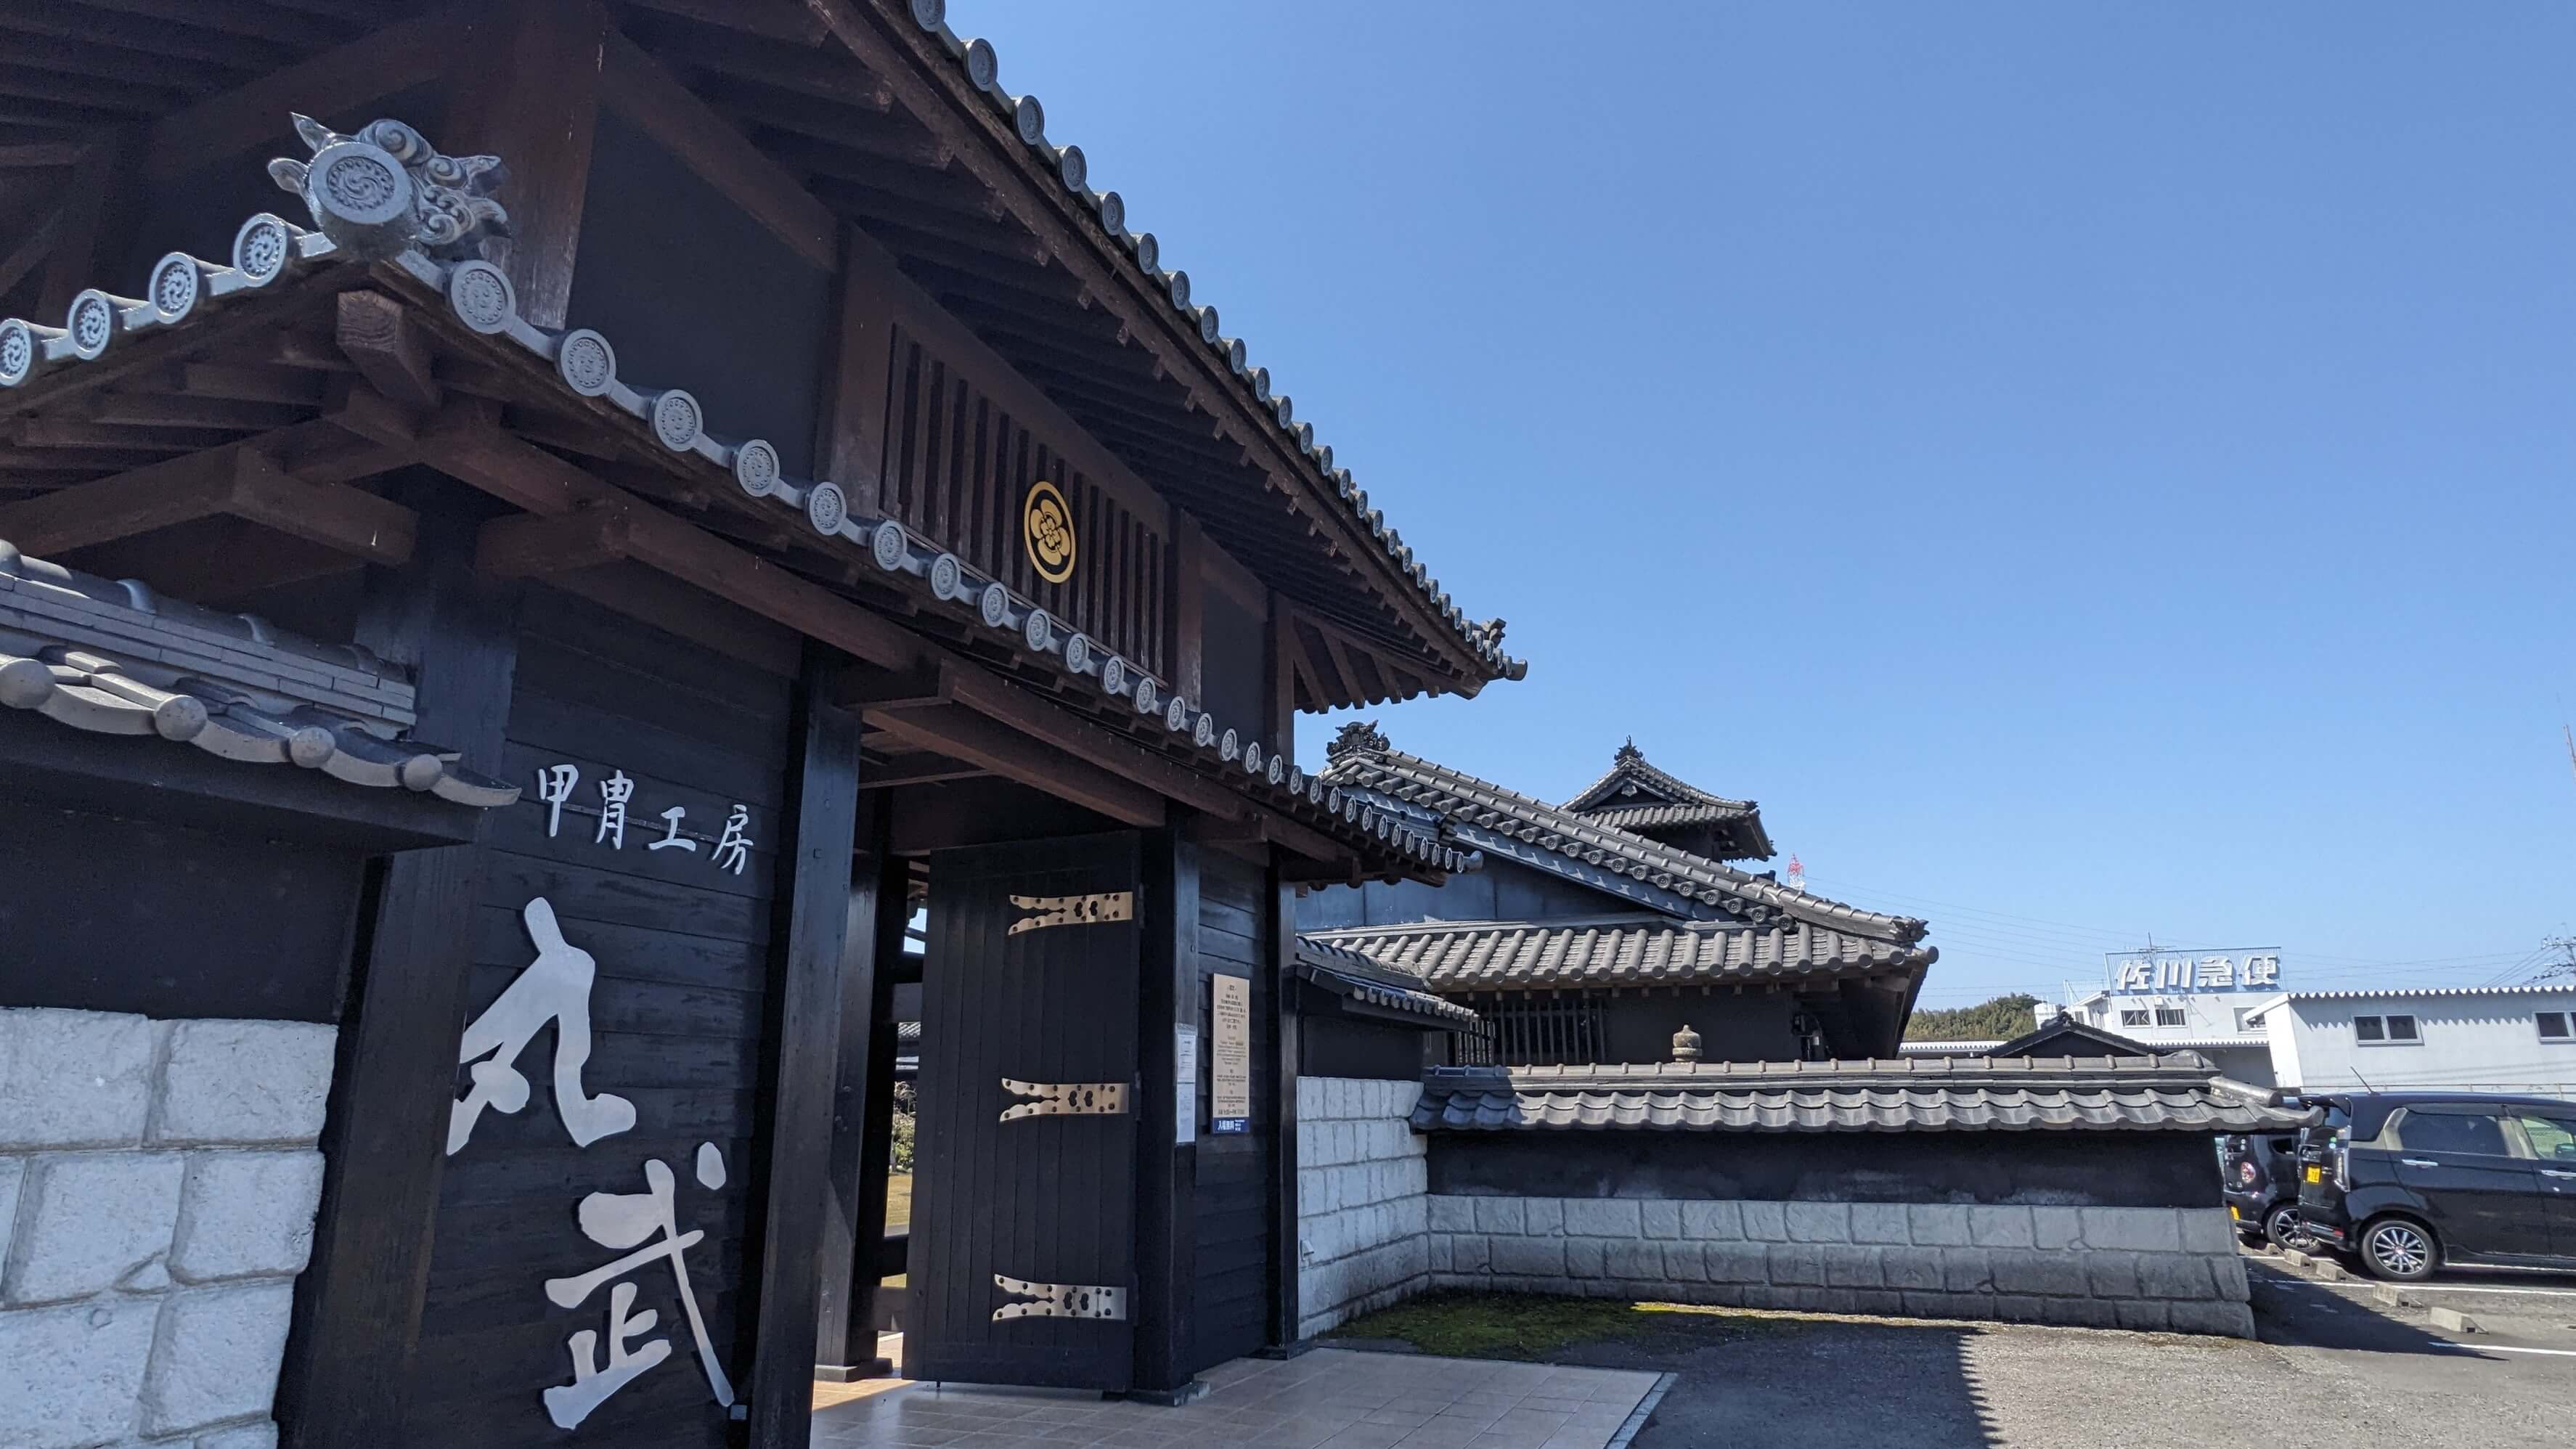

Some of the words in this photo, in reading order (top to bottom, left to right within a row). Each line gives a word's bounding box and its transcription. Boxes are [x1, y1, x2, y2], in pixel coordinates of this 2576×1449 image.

[538, 764, 754, 875] 甲冑工房
[2115, 952, 2279, 991] 佐川急便
